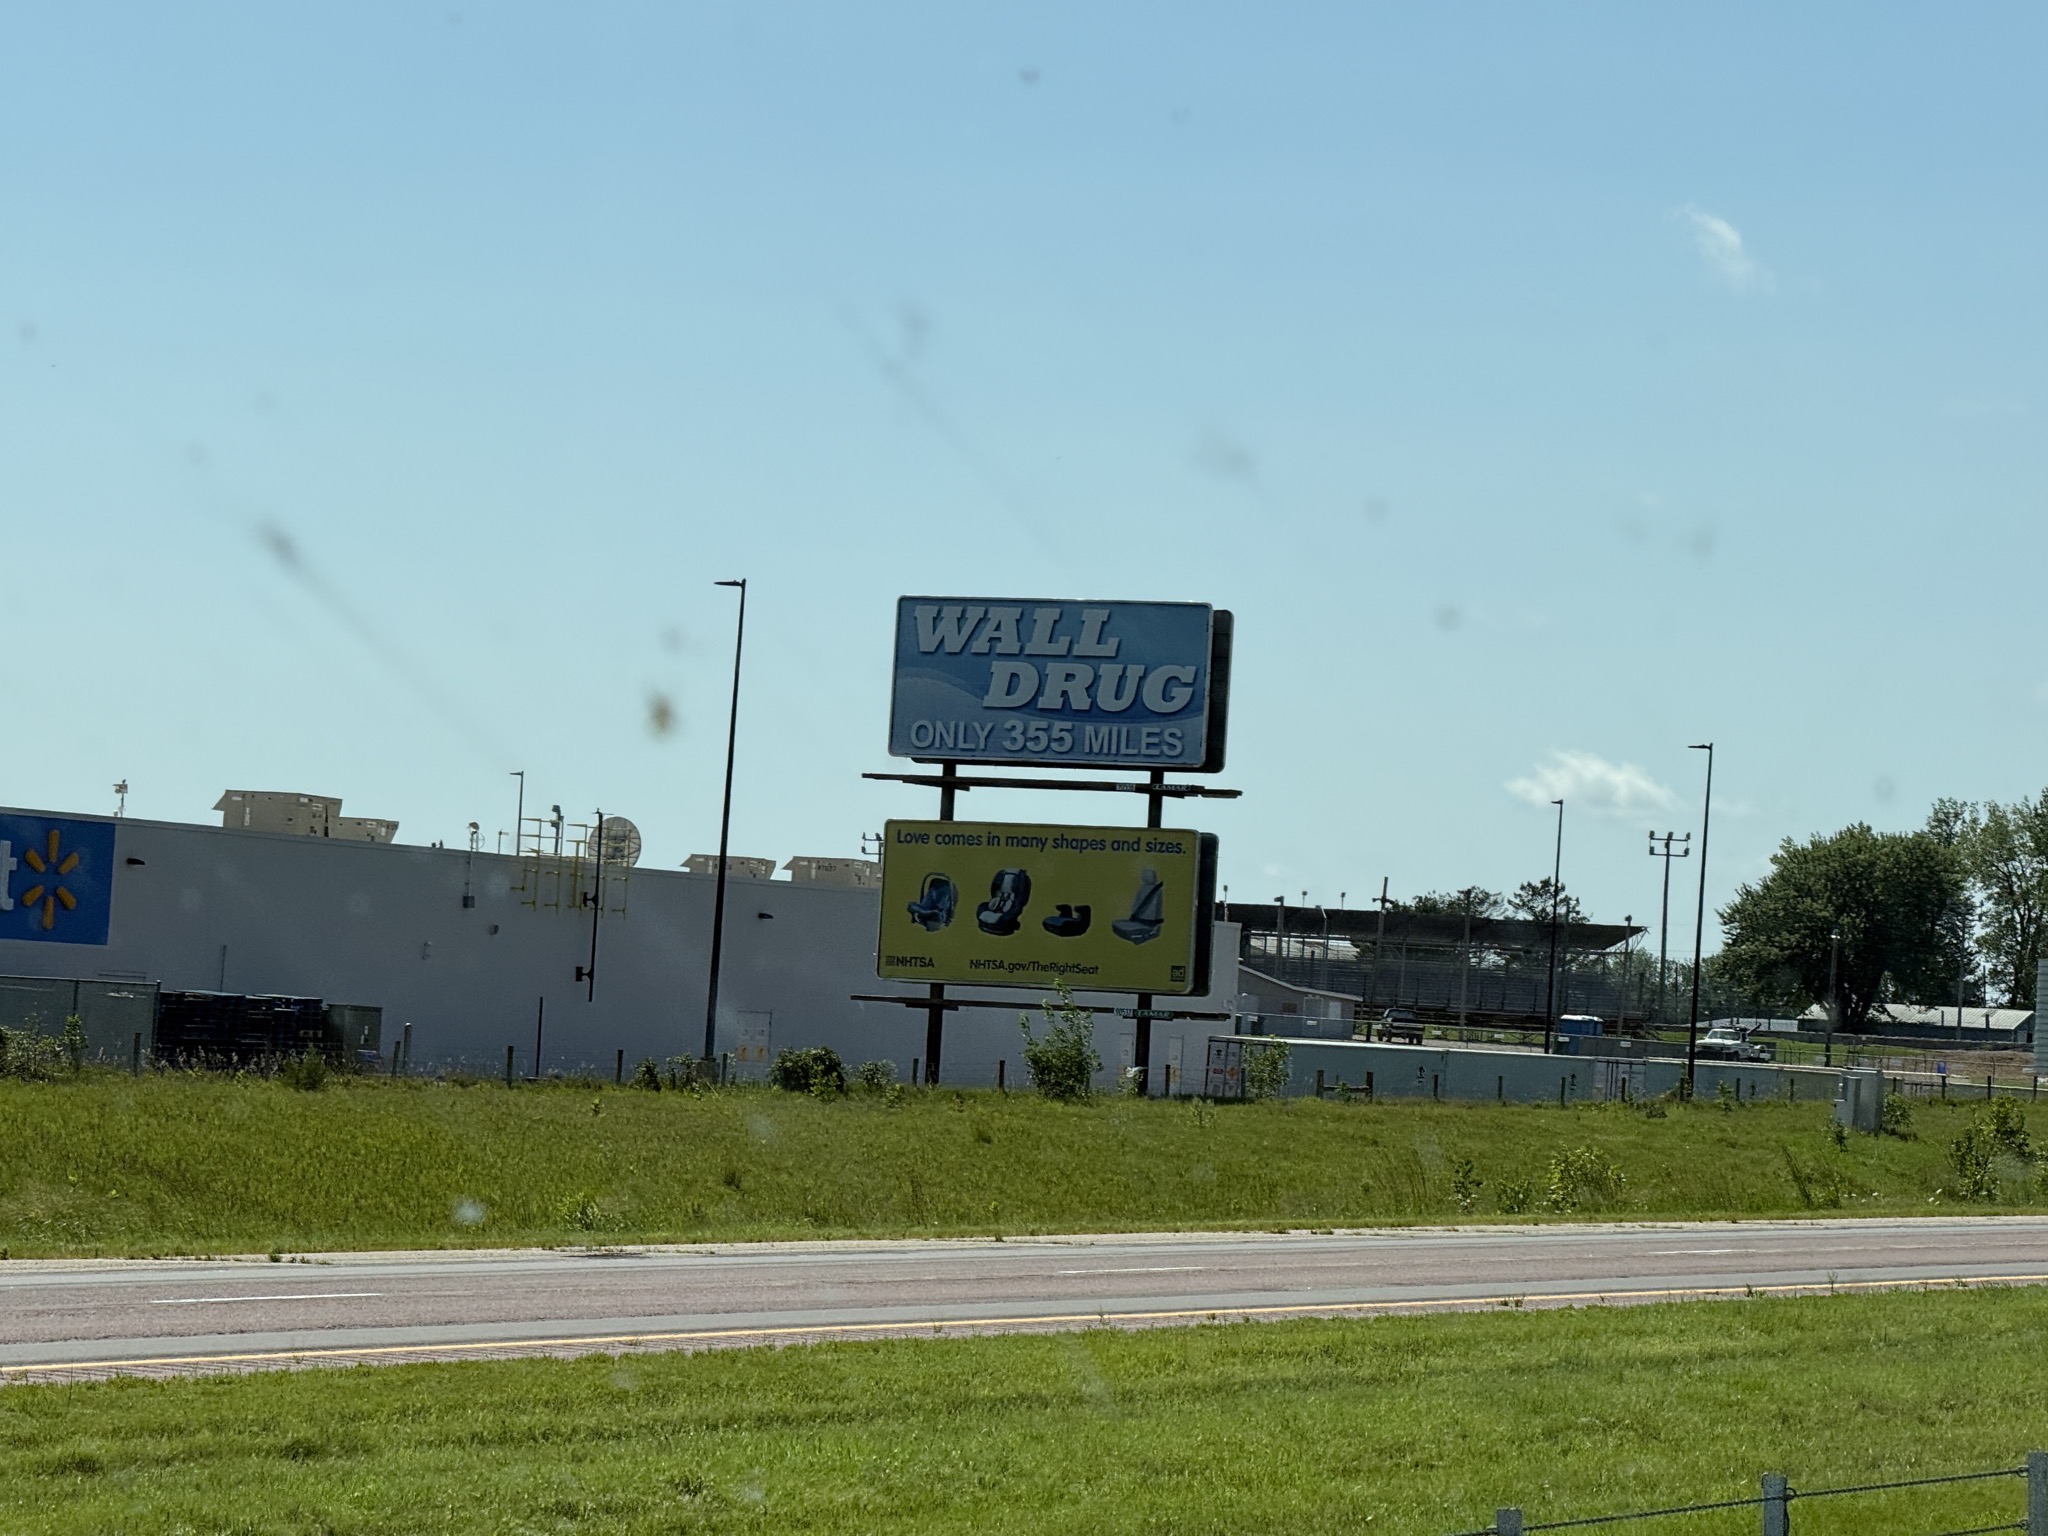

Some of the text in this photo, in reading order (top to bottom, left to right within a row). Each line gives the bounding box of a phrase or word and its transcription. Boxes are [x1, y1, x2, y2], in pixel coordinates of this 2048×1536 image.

[914, 605, 1119, 657] WALL
[983, 661, 1199, 713] DRUG
[910, 719, 1184, 756] ONLY 355 MILES
[896, 829, 1187, 855] Love comes in many shapes and sizes.
[896, 956, 935, 968] NHTSA
[969, 959, 1099, 975] NHTSA.gov/TheRightSeat
